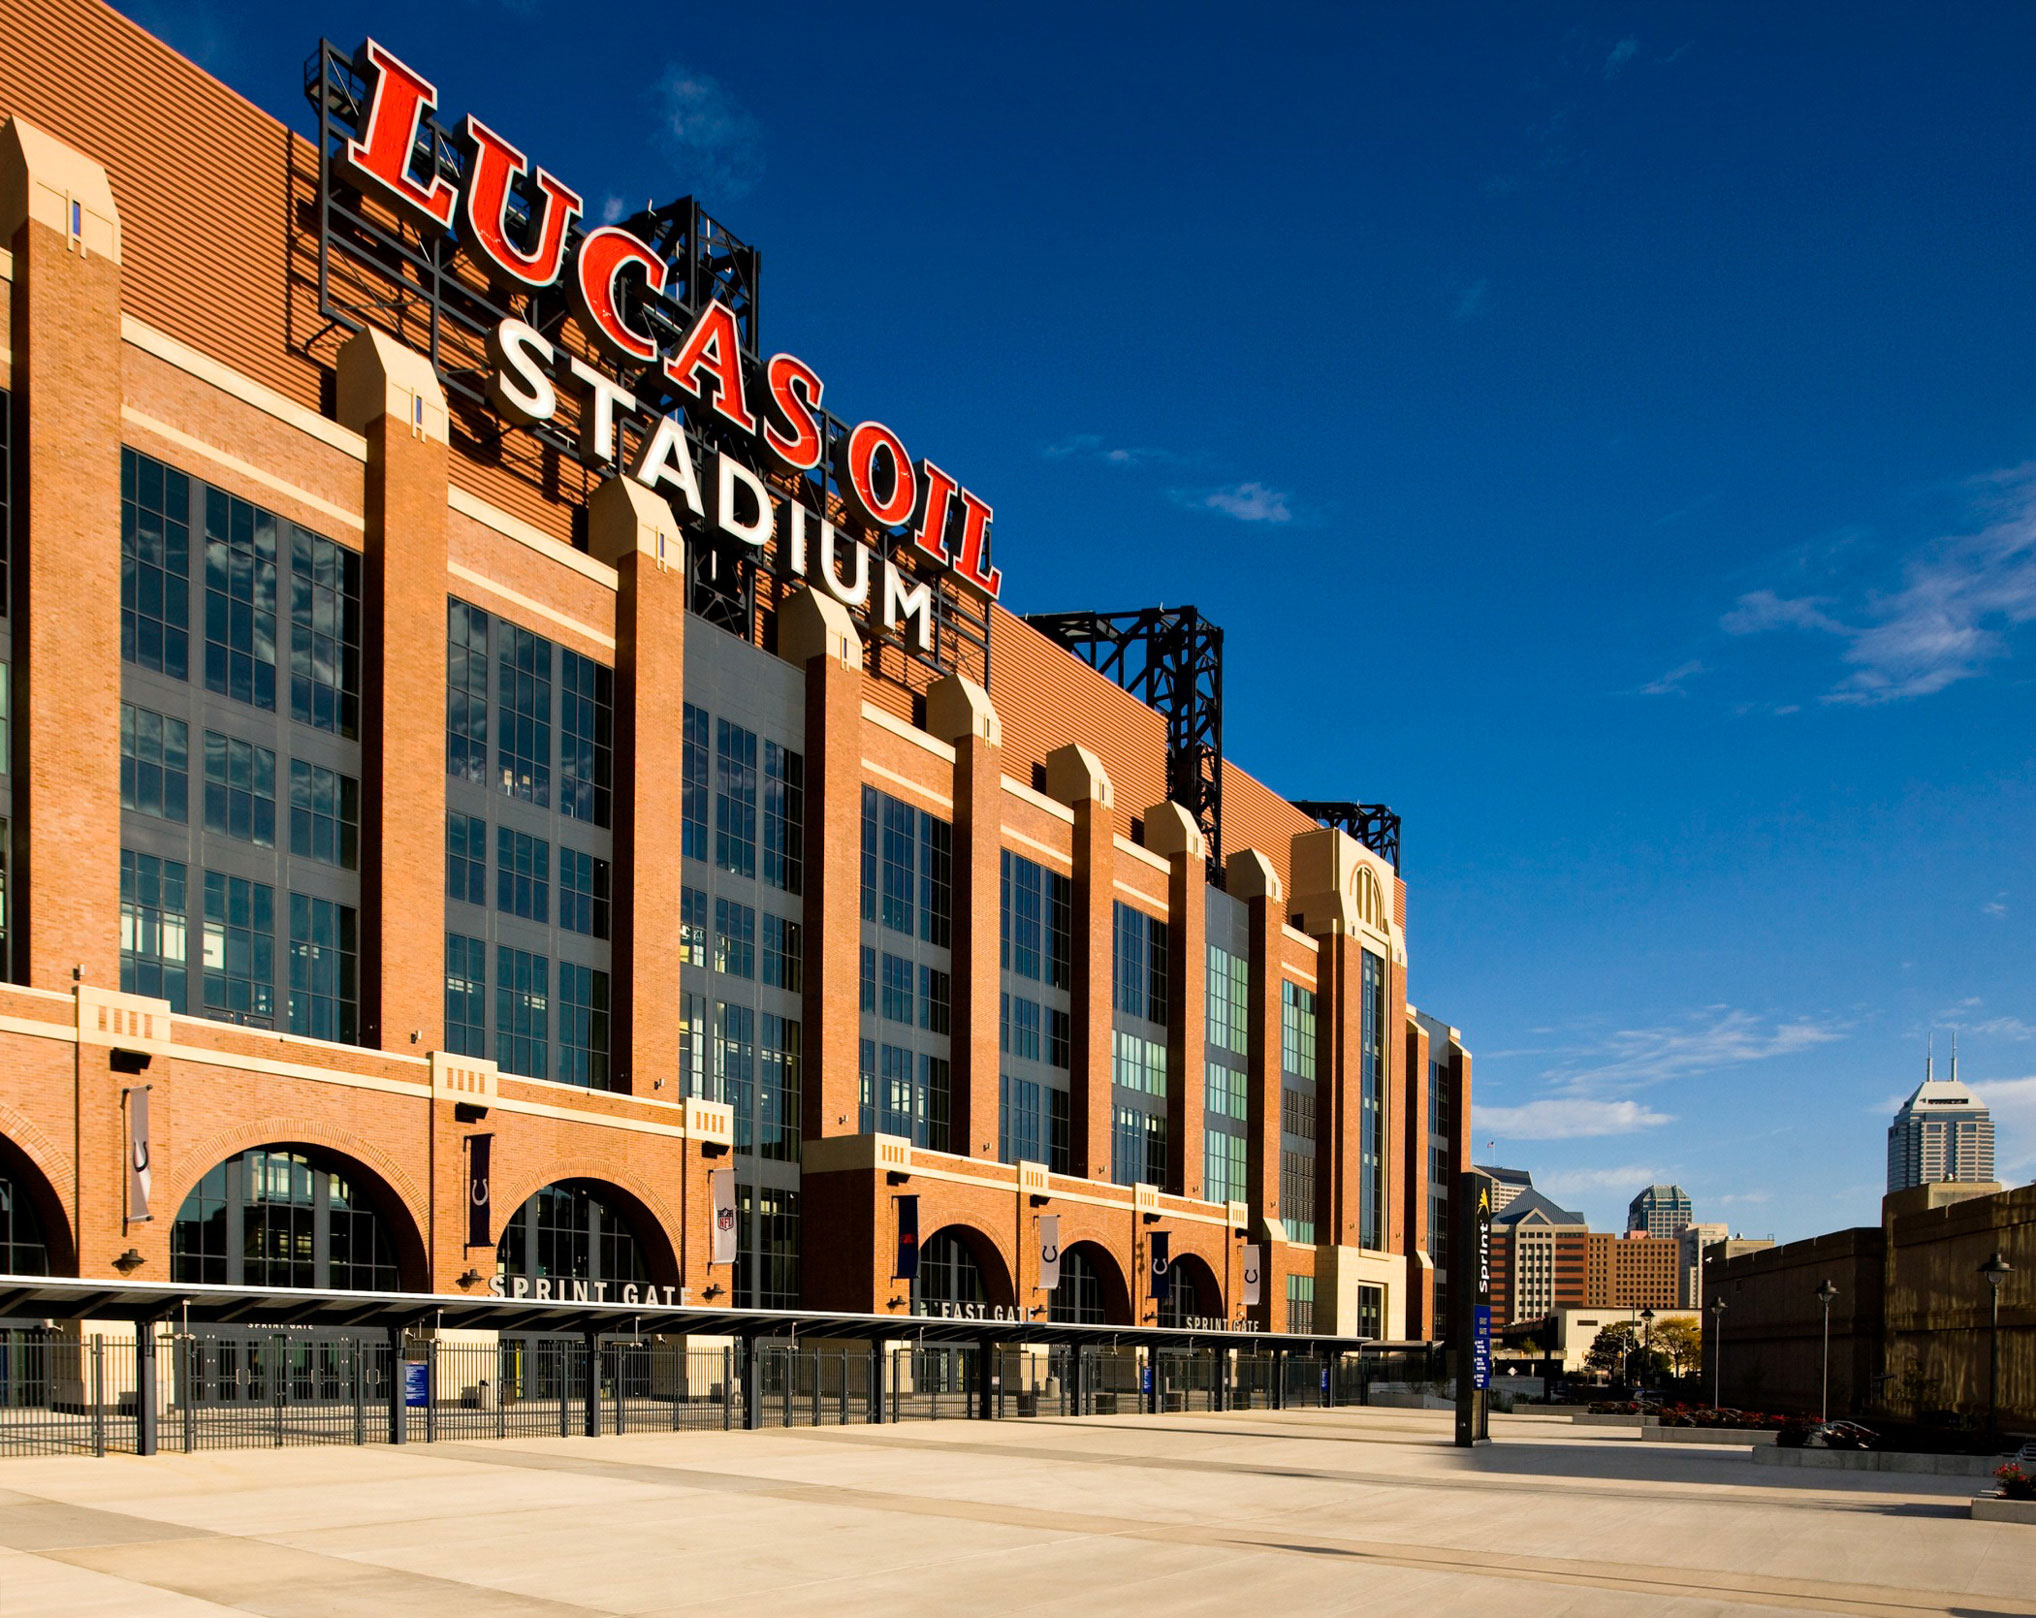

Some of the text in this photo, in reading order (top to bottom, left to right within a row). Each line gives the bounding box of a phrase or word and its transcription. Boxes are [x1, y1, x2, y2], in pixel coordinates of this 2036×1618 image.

[347, 37, 1001, 600] LUCAS OIL
[498, 318, 931, 651] STADIUM
[719, 1217, 732, 1228] NFL
[1479, 1222, 1489, 1293] Sprint
[488, 1275, 691, 1306] SPRINT GATE
[941, 1302, 985, 1320] EAST
[1187, 1317, 1259, 1332] SPRINT GATE
